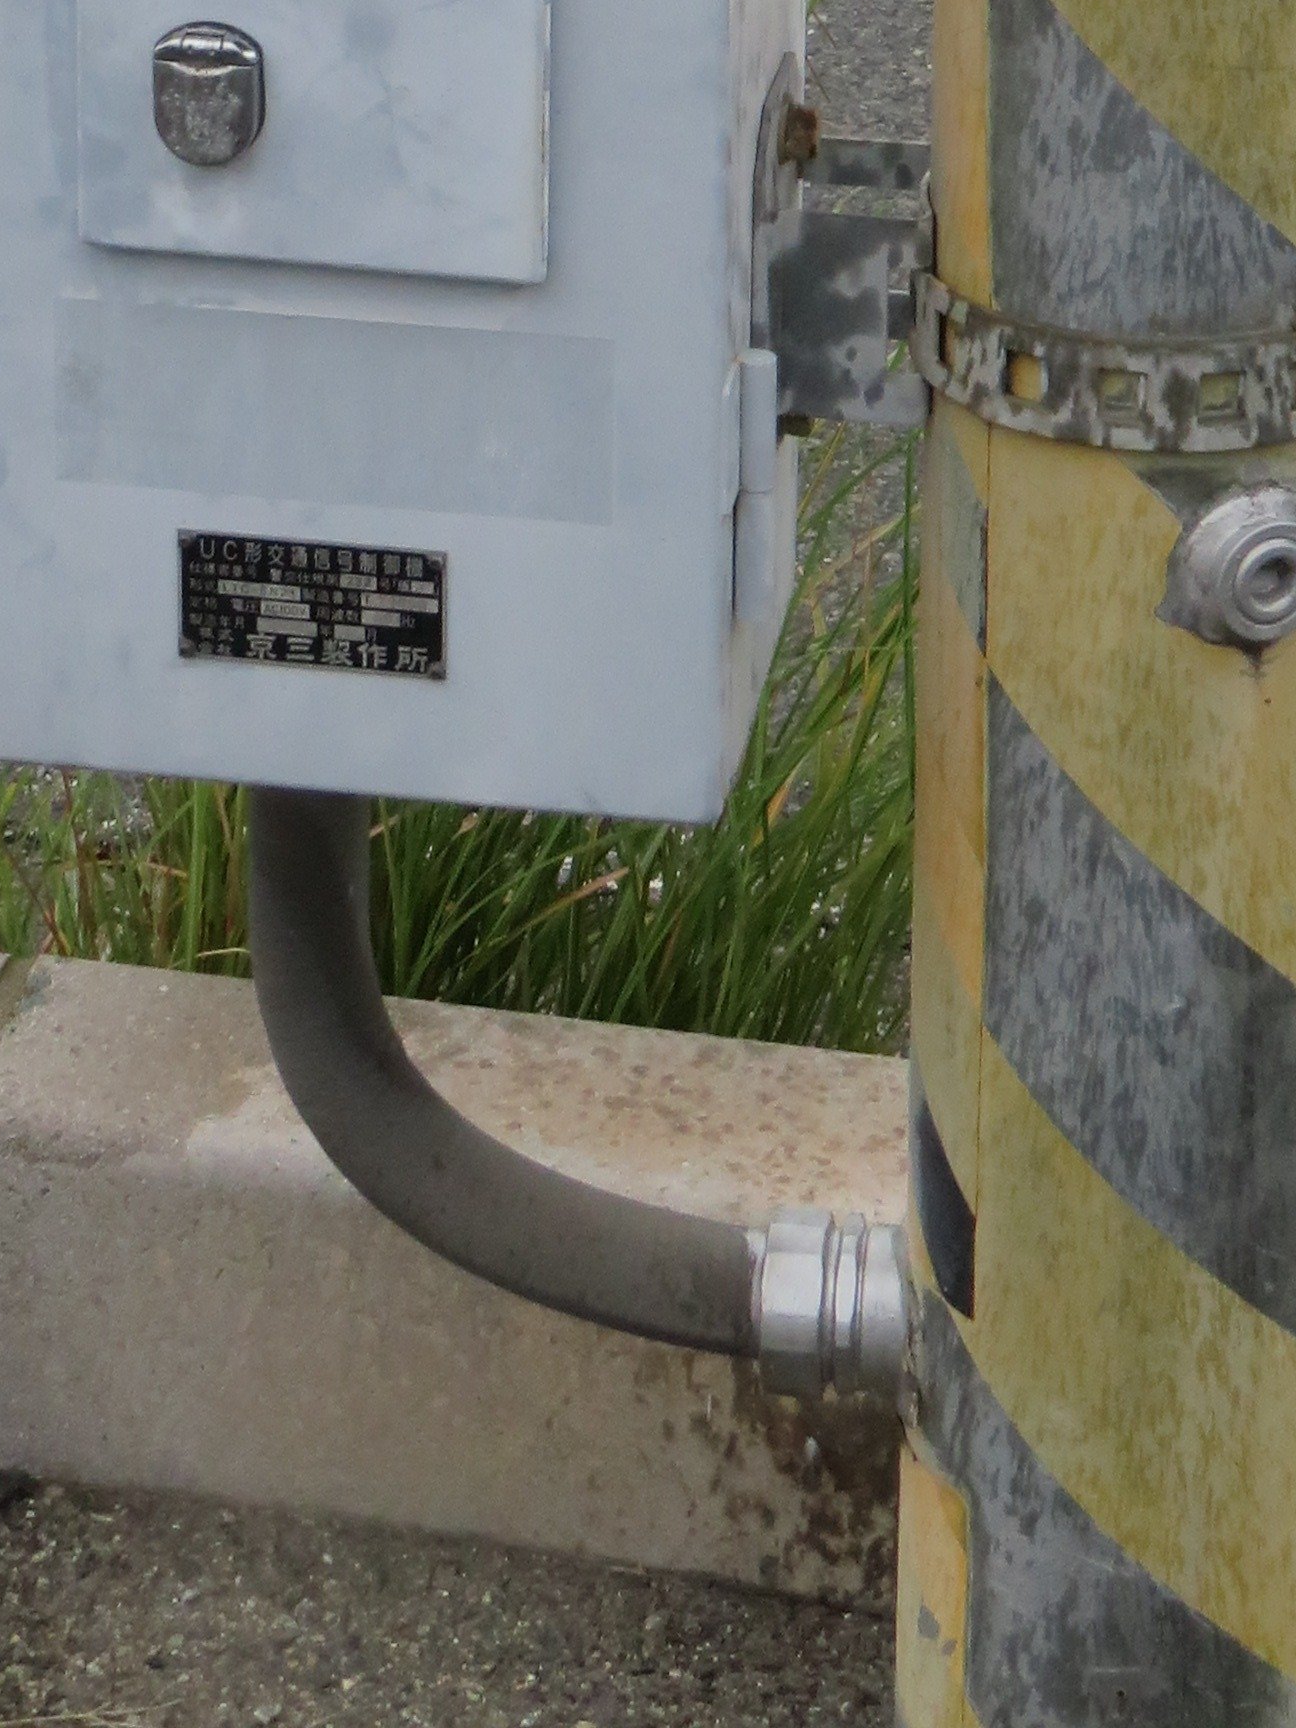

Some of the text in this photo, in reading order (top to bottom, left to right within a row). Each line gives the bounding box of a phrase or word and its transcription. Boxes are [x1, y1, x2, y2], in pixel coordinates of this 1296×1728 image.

[246, 633, 429, 673] 京三製作所
